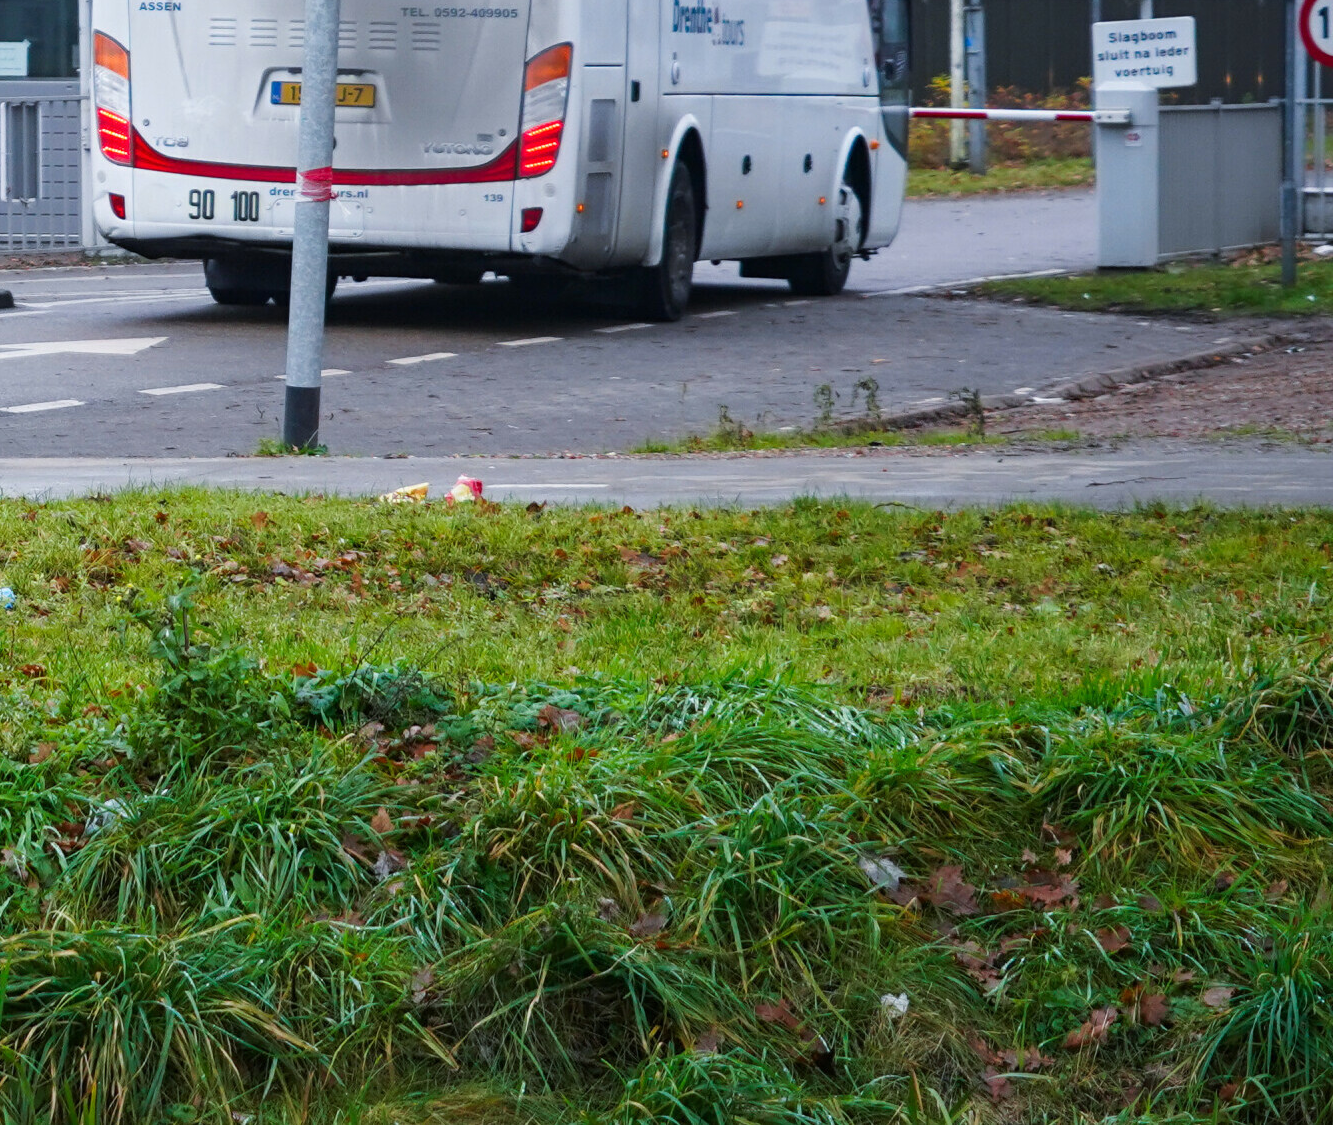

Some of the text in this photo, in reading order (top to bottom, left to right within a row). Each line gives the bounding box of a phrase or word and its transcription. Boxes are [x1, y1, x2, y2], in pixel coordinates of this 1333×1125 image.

[139, 1, 182, 11] ASSEN
[400, 7, 430, 17] TEL.
[1108, 30, 1177, 44] Slagboom
[1097, 49, 1129, 61] sluit
[1134, 50, 1150, 59] na
[1114, 65, 1174, 77] voertuig
[188, 188, 215, 220] 90
[230, 190, 260, 222] 100
